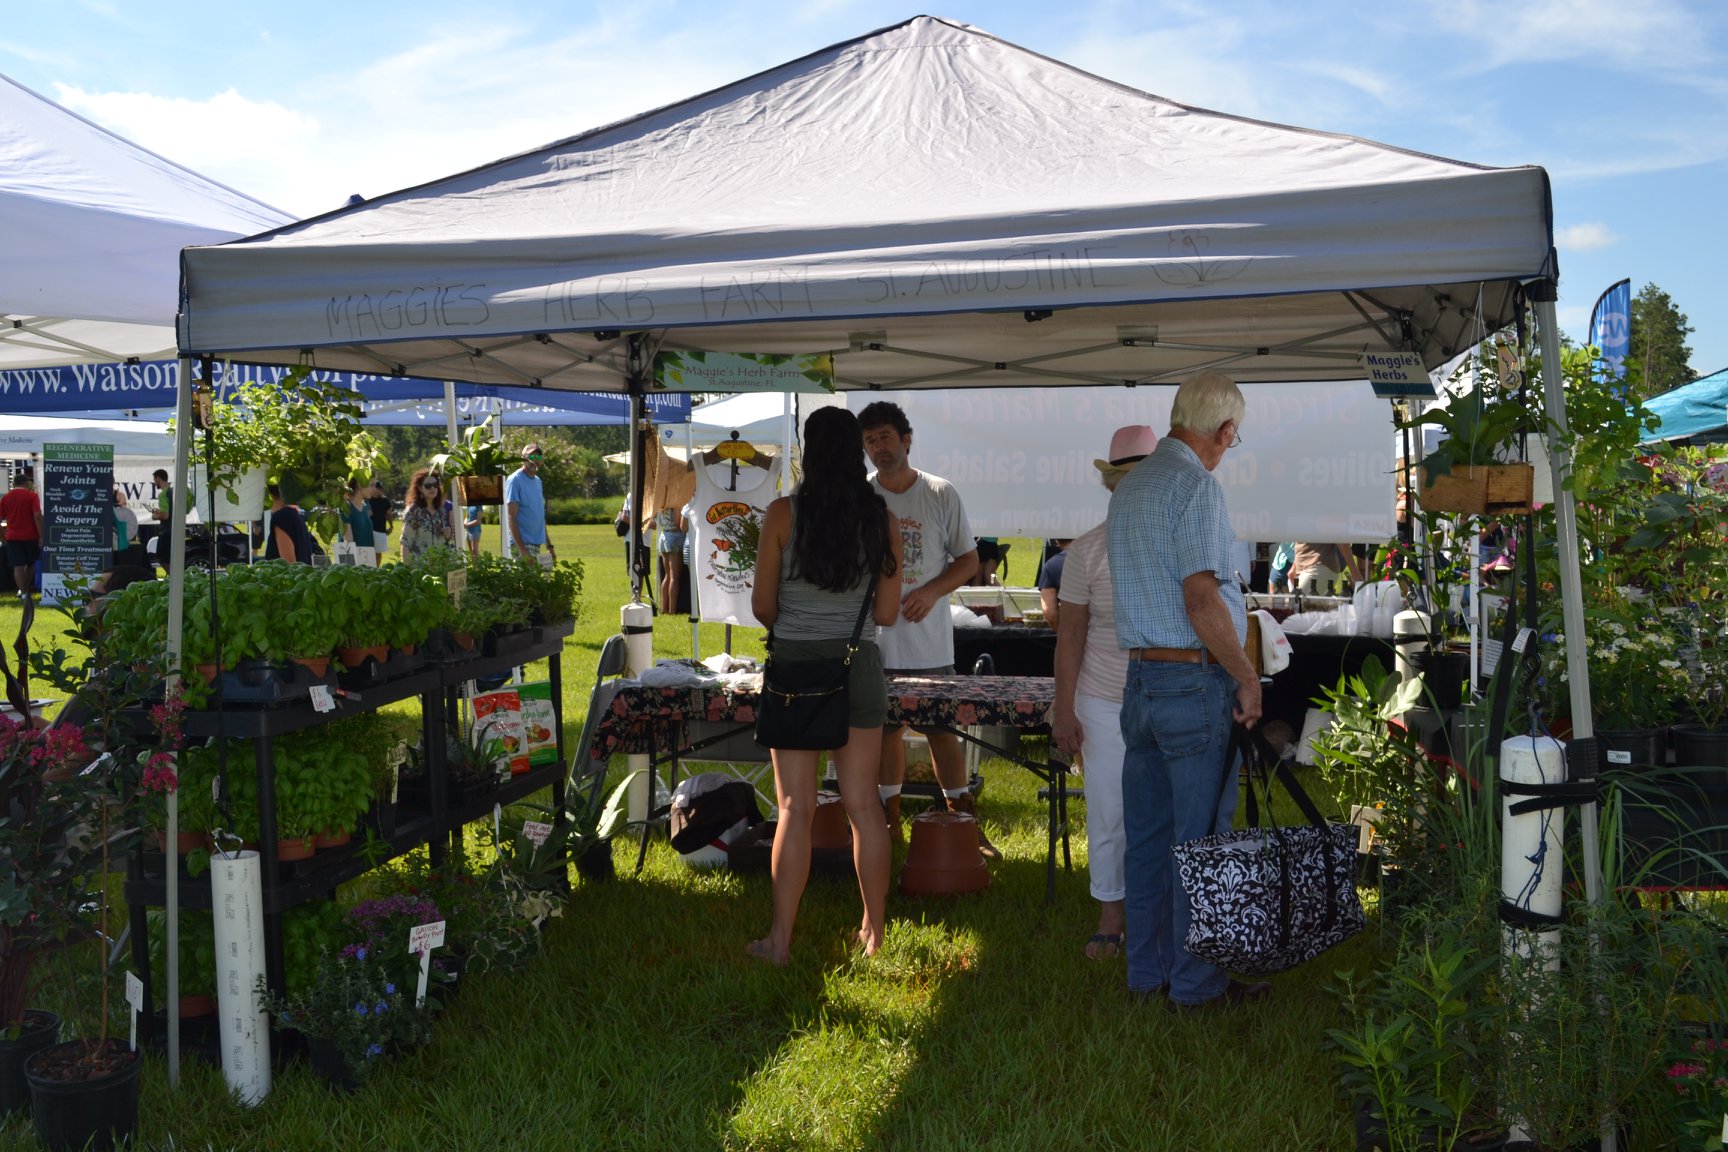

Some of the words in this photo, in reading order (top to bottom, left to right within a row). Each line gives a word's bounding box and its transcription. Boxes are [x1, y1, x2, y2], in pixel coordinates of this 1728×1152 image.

[544, 276, 655, 324] HERB
[700, 265, 814, 320] FARM
[1366, 354, 1420, 369] Maggie's
[685, 366, 734, 380] Maggie's
[737, 367, 767, 377] Herb
[770, 367, 800, 378] Farm
[1372, 369, 1408, 380] Herbs
[46, 444, 112, 452] REGENERATIVE
[44, 463, 83, 473] Renew
[85, 464, 113, 474] Your
[60, 475, 96, 485] Joints
[50, 505, 82, 513] Avoid
[84, 505, 103, 513] The
[55, 515, 98, 525] Surgery
